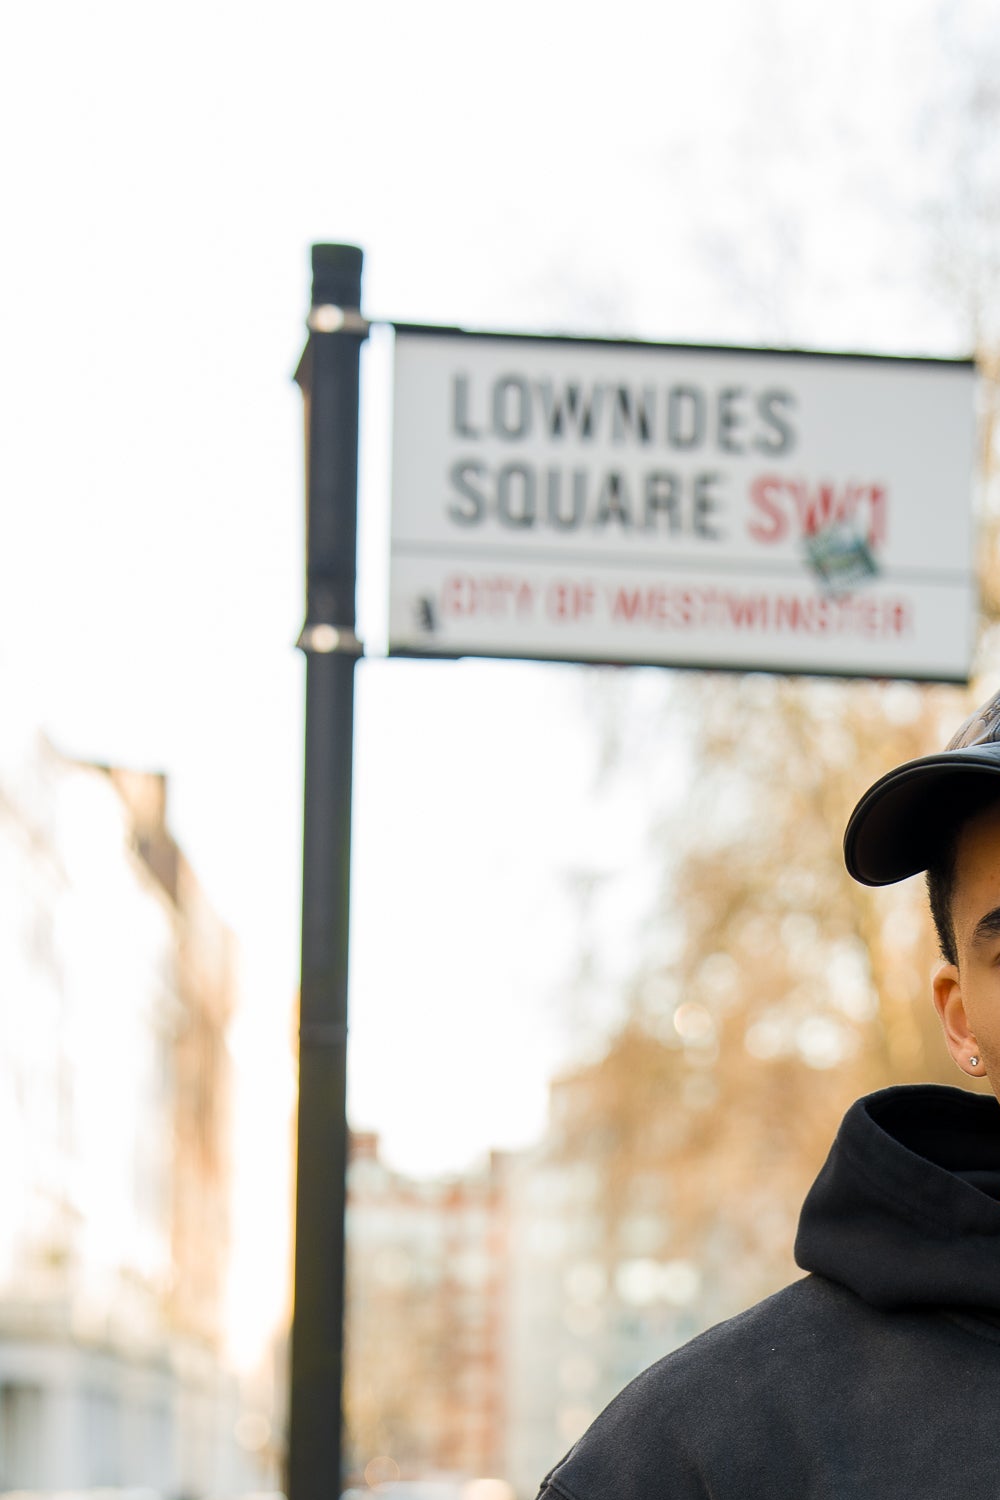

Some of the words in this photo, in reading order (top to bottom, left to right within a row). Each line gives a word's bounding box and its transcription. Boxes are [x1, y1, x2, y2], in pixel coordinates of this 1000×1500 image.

[450, 372, 797, 458] LOWNDES
[447, 456, 730, 541] SQUARE
[441, 573, 534, 619] CITY
[548, 578, 598, 625] OF
[608, 585, 914, 640] WESTMINSTER
